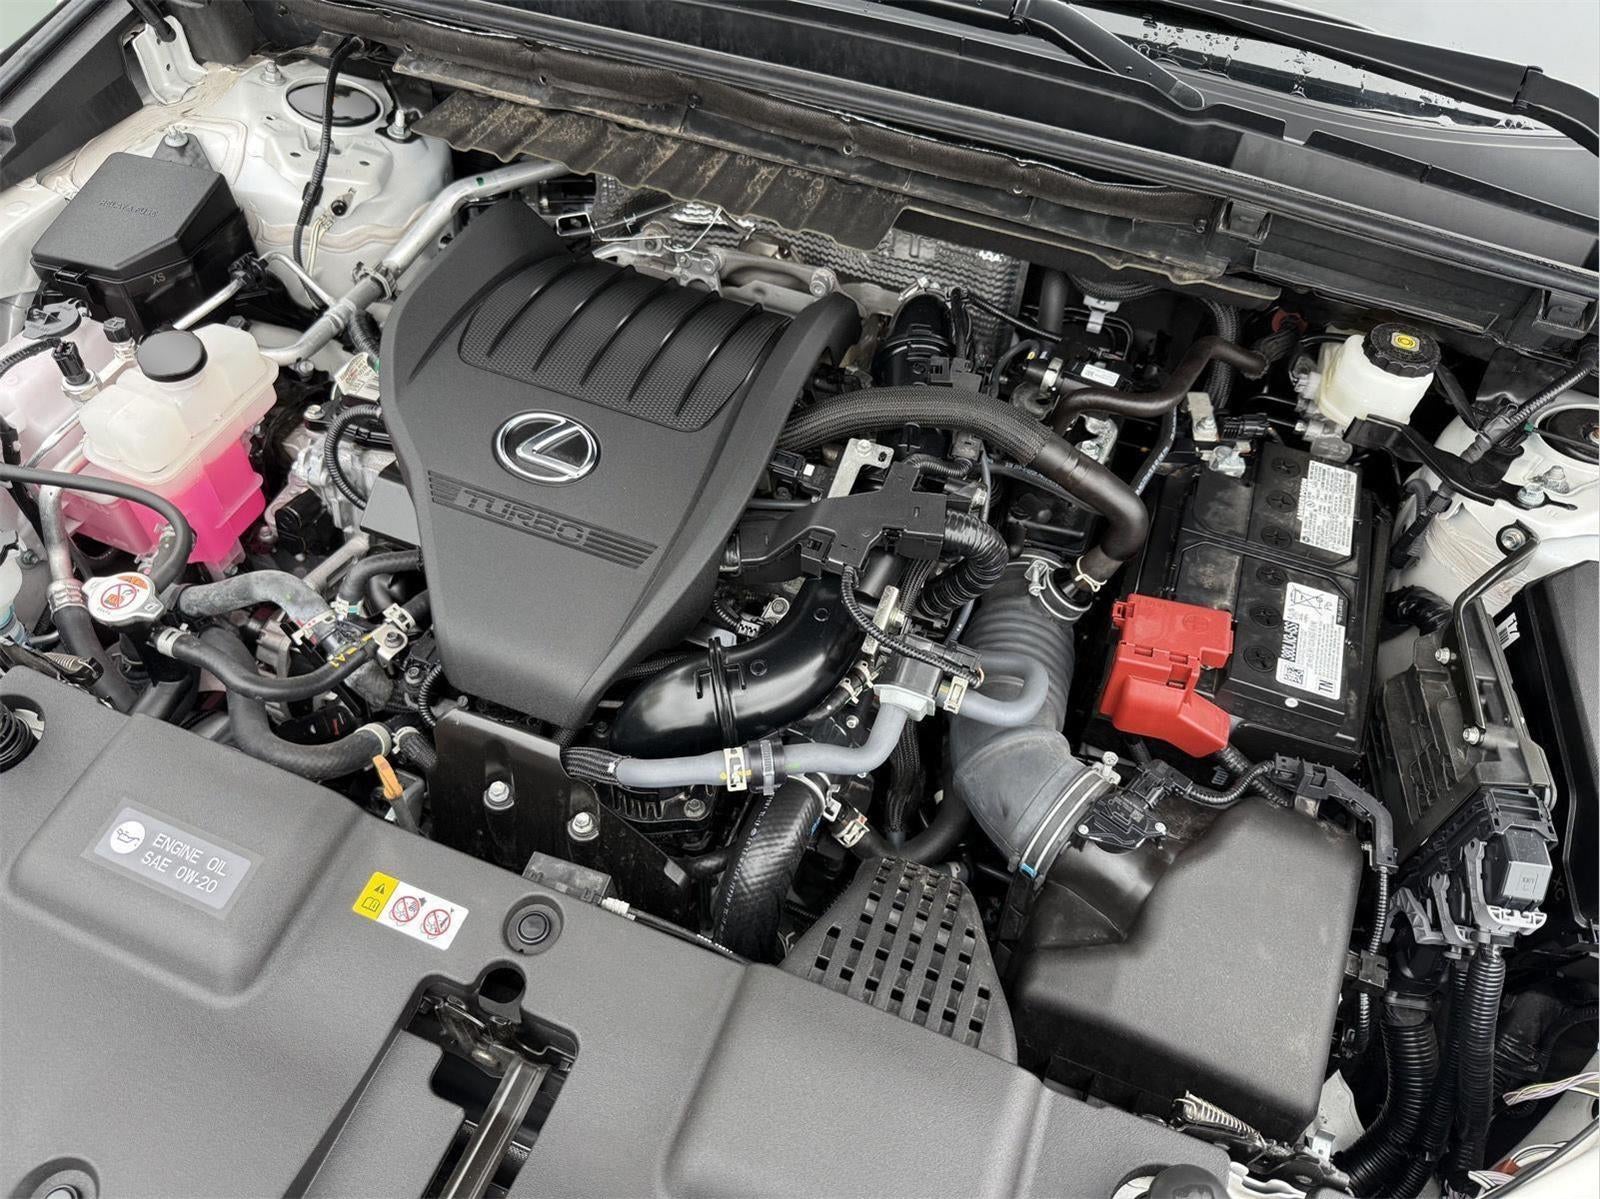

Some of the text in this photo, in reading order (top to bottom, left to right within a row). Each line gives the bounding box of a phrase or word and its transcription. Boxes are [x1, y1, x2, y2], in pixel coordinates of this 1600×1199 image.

[463, 488, 585, 544] TURBO
[1319, 679, 1334, 693] TN
[141, 851, 218, 893] SAE 0W-20
[152, 833, 227, 876] ENGINE OIL
